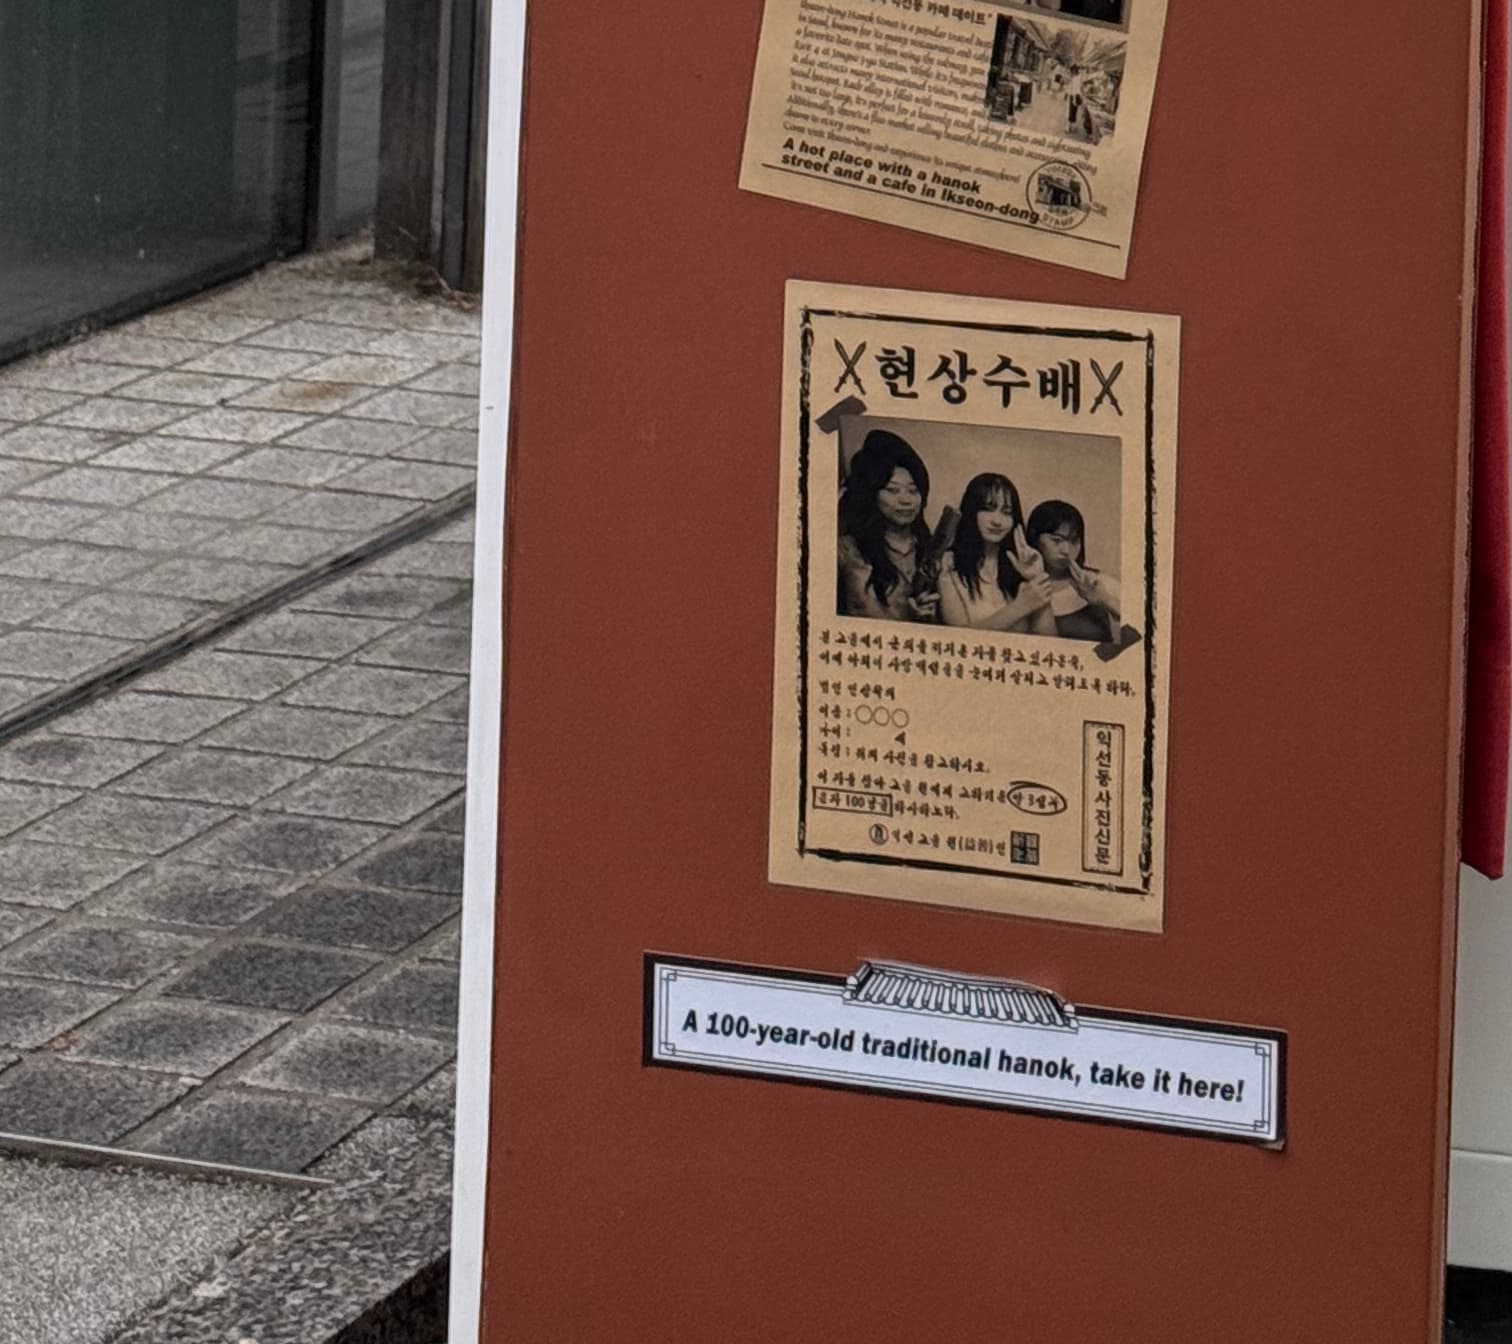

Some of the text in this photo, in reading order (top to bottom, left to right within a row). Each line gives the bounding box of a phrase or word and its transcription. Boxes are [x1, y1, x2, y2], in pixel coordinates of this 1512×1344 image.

[781, 153, 1040, 225] street and a cafe in Ikseon-dong
[782, 136, 982, 195] A hot place with a hanok
[874, 345, 1082, 415] 현상수배
[1094, 729, 1114, 868] 익선동사진신문
[681, 1009, 1244, 1102] A 100-year-old traditional hanok, take it here!
